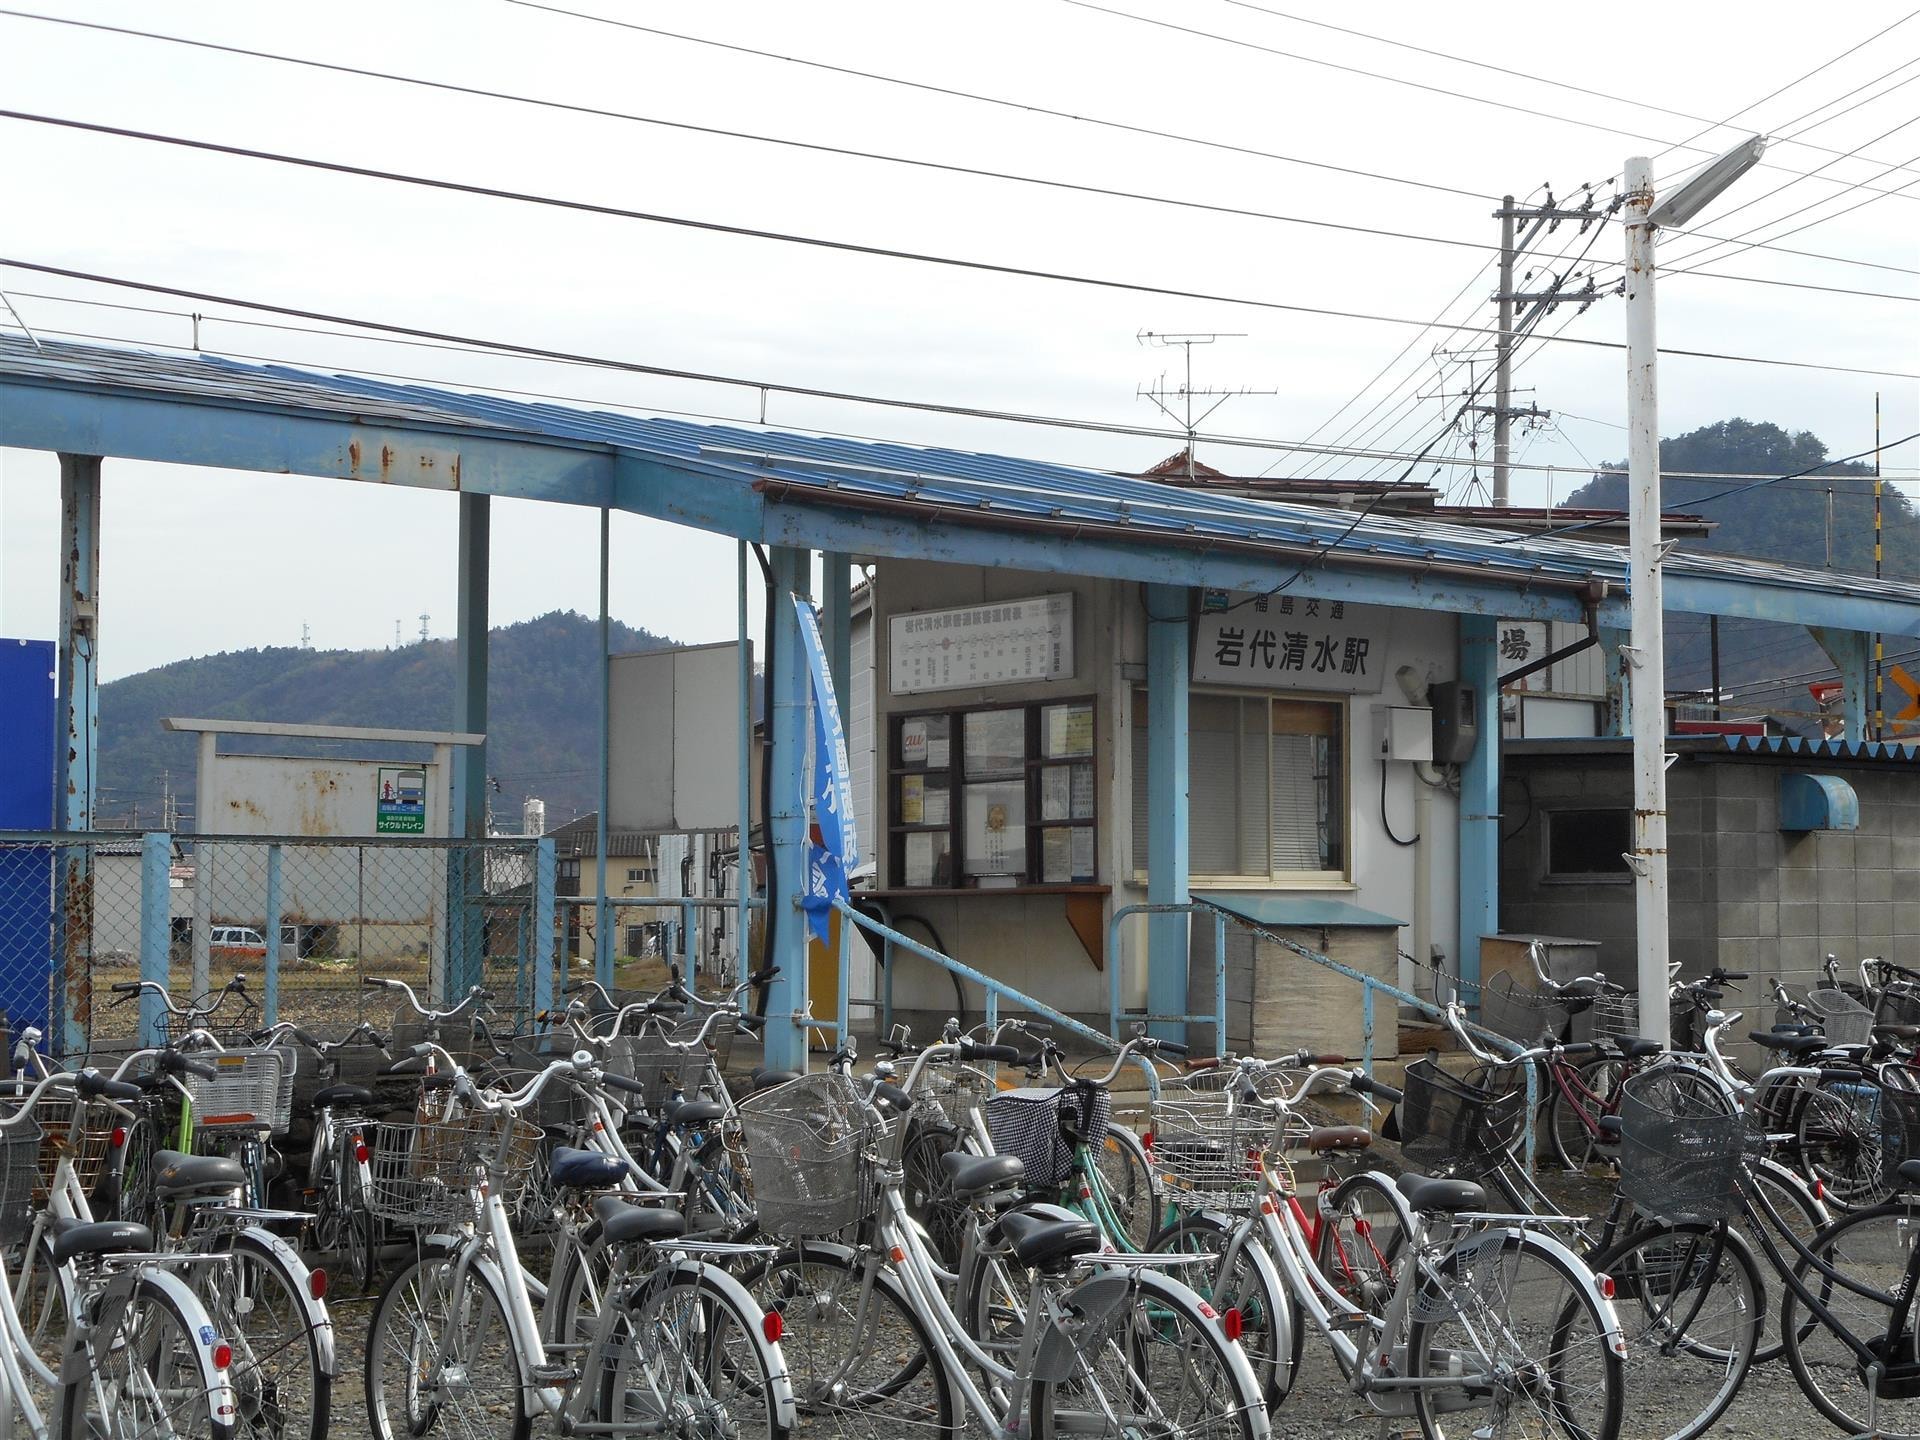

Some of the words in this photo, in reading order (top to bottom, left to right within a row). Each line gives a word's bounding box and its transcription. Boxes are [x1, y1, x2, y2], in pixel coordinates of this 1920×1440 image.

[1254, 593, 1345, 620] 福島交通
[1215, 627, 1370, 676] 岩代清水駅
[1500, 628, 1531, 661] 場
[378, 821, 424, 830] サイクルトレイン
